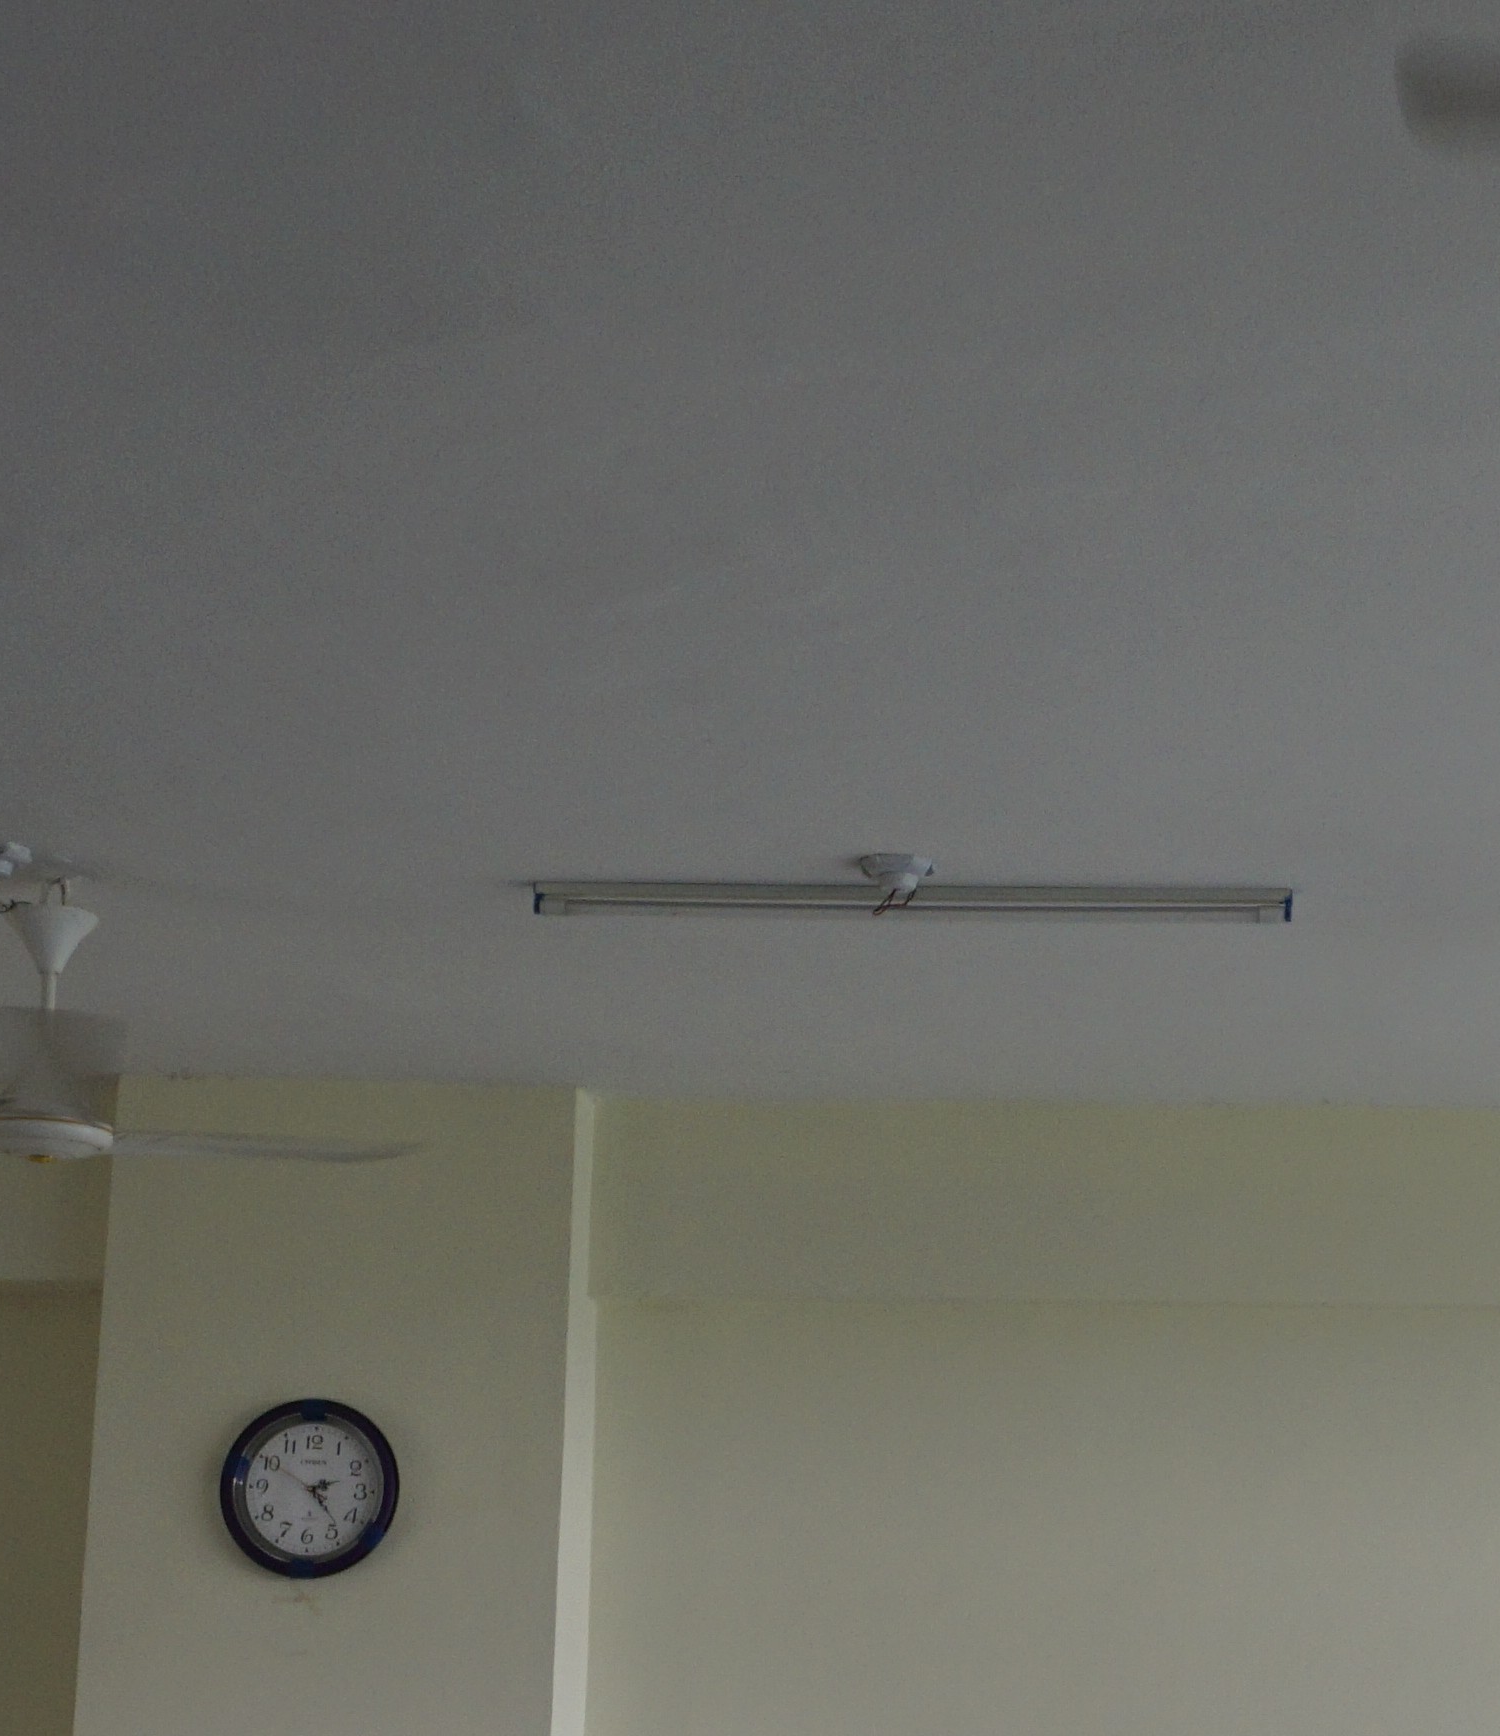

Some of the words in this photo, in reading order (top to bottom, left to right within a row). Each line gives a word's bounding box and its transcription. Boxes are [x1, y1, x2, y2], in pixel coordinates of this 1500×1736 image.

[306, 1434, 323, 1450] 12
[336, 1441, 341, 1456] 1
[264, 1455, 280, 1471] 10
[349, 1460, 362, 1476] 2
[256, 1478, 269, 1495] 9
[353, 1483, 367, 1501] 3
[260, 1504, 274, 1521] 8
[343, 1507, 358, 1523] 4
[279, 1521, 293, 1538] 7
[300, 1527, 314, 1544] 6
[325, 1524, 338, 1540] 5
